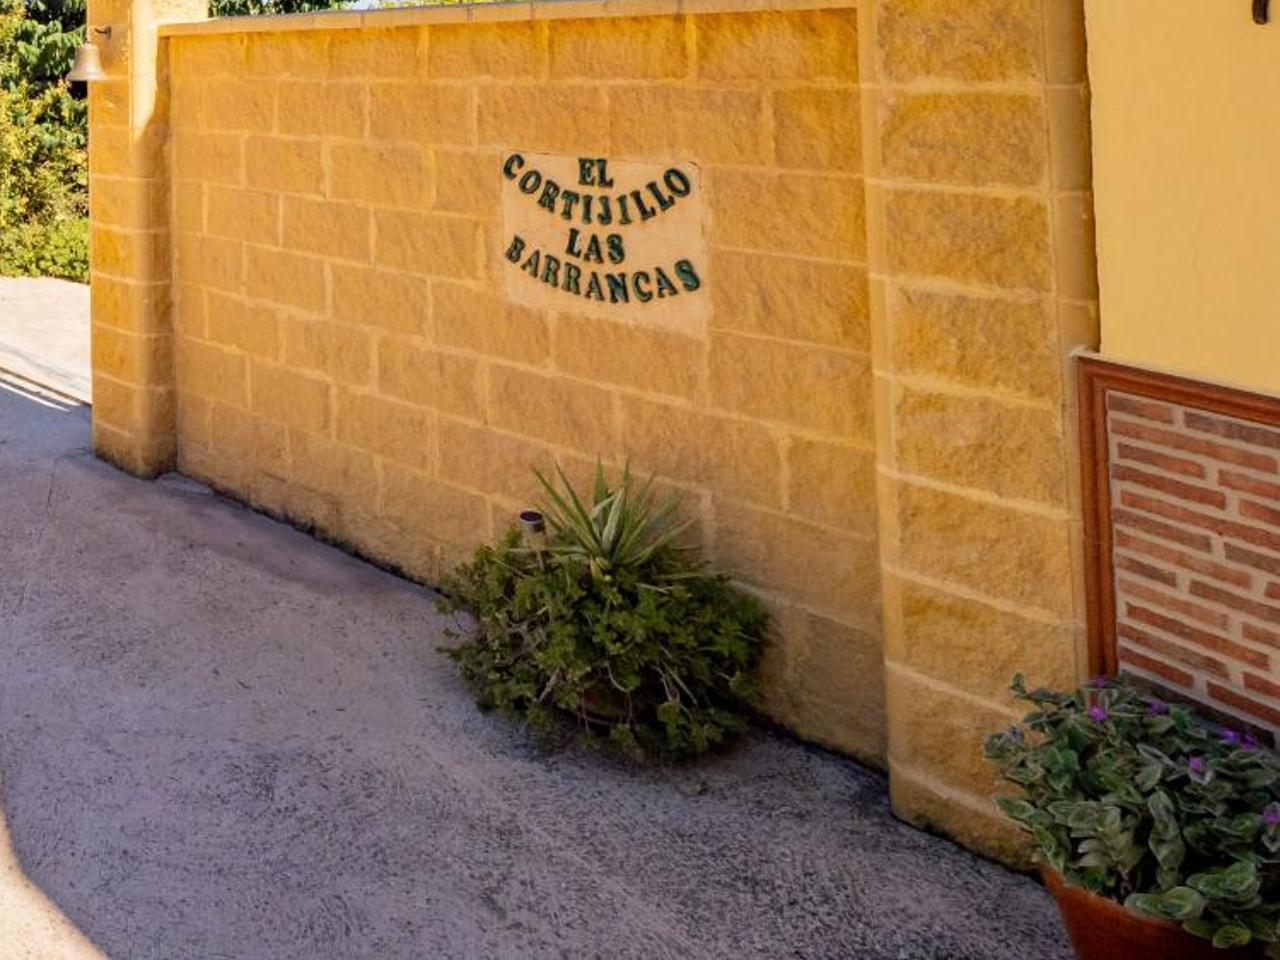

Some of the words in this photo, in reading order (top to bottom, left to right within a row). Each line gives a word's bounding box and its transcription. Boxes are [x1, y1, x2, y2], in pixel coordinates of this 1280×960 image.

[503, 154, 691, 225] CORTIJILLO
[578, 157, 613, 188] EL
[505, 235, 701, 303] BARRANCAS
[565, 228, 625, 264] LAS
